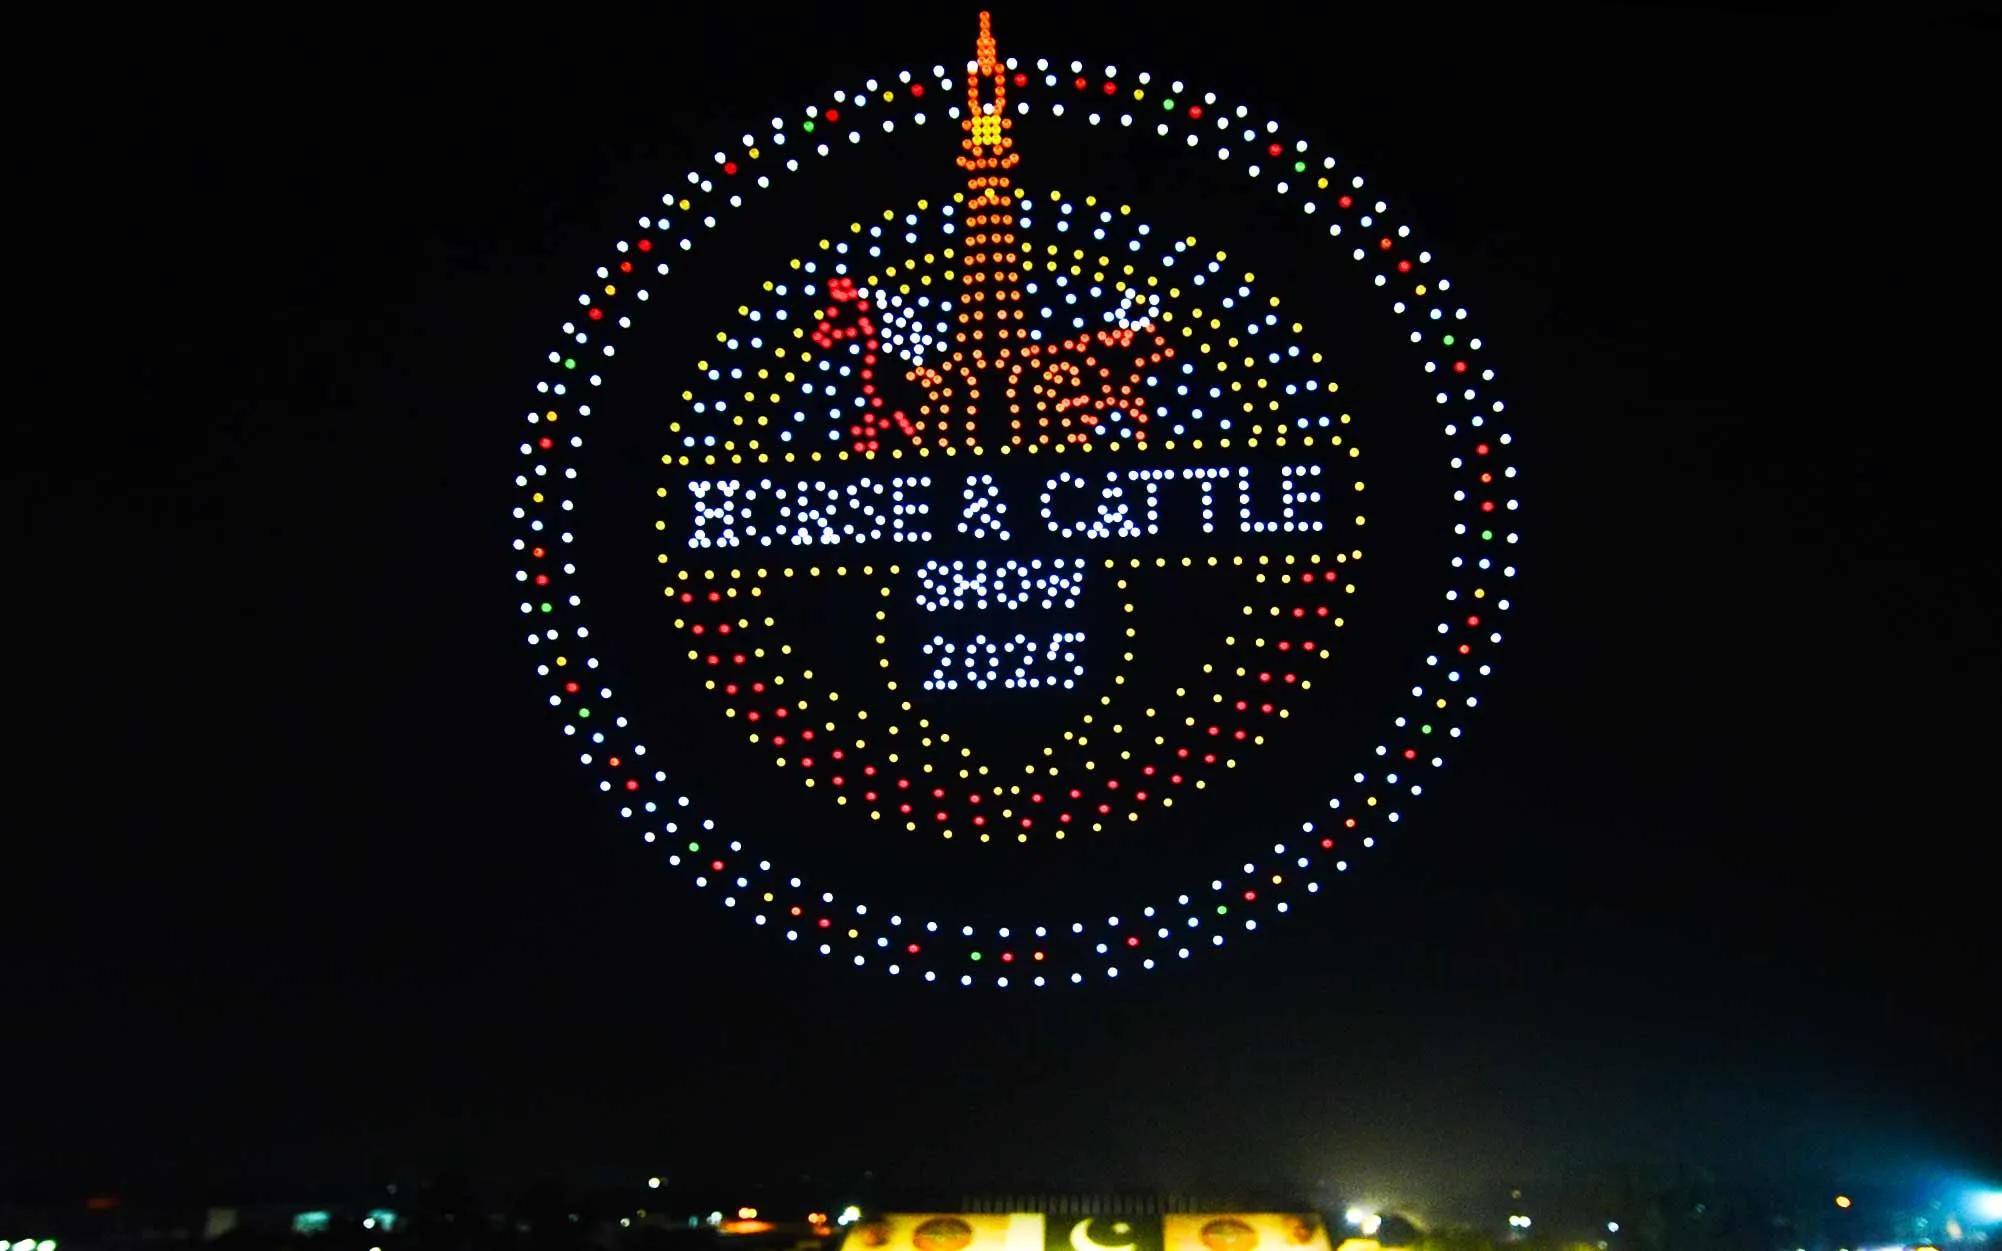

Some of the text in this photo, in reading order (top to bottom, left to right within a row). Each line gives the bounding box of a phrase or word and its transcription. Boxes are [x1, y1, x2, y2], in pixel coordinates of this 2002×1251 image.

[687, 476, 933, 549] HORSE
[1039, 465, 1323, 540] CATTLE
[915, 558, 1086, 612] SHOW
[922, 631, 1086, 691] 2025
